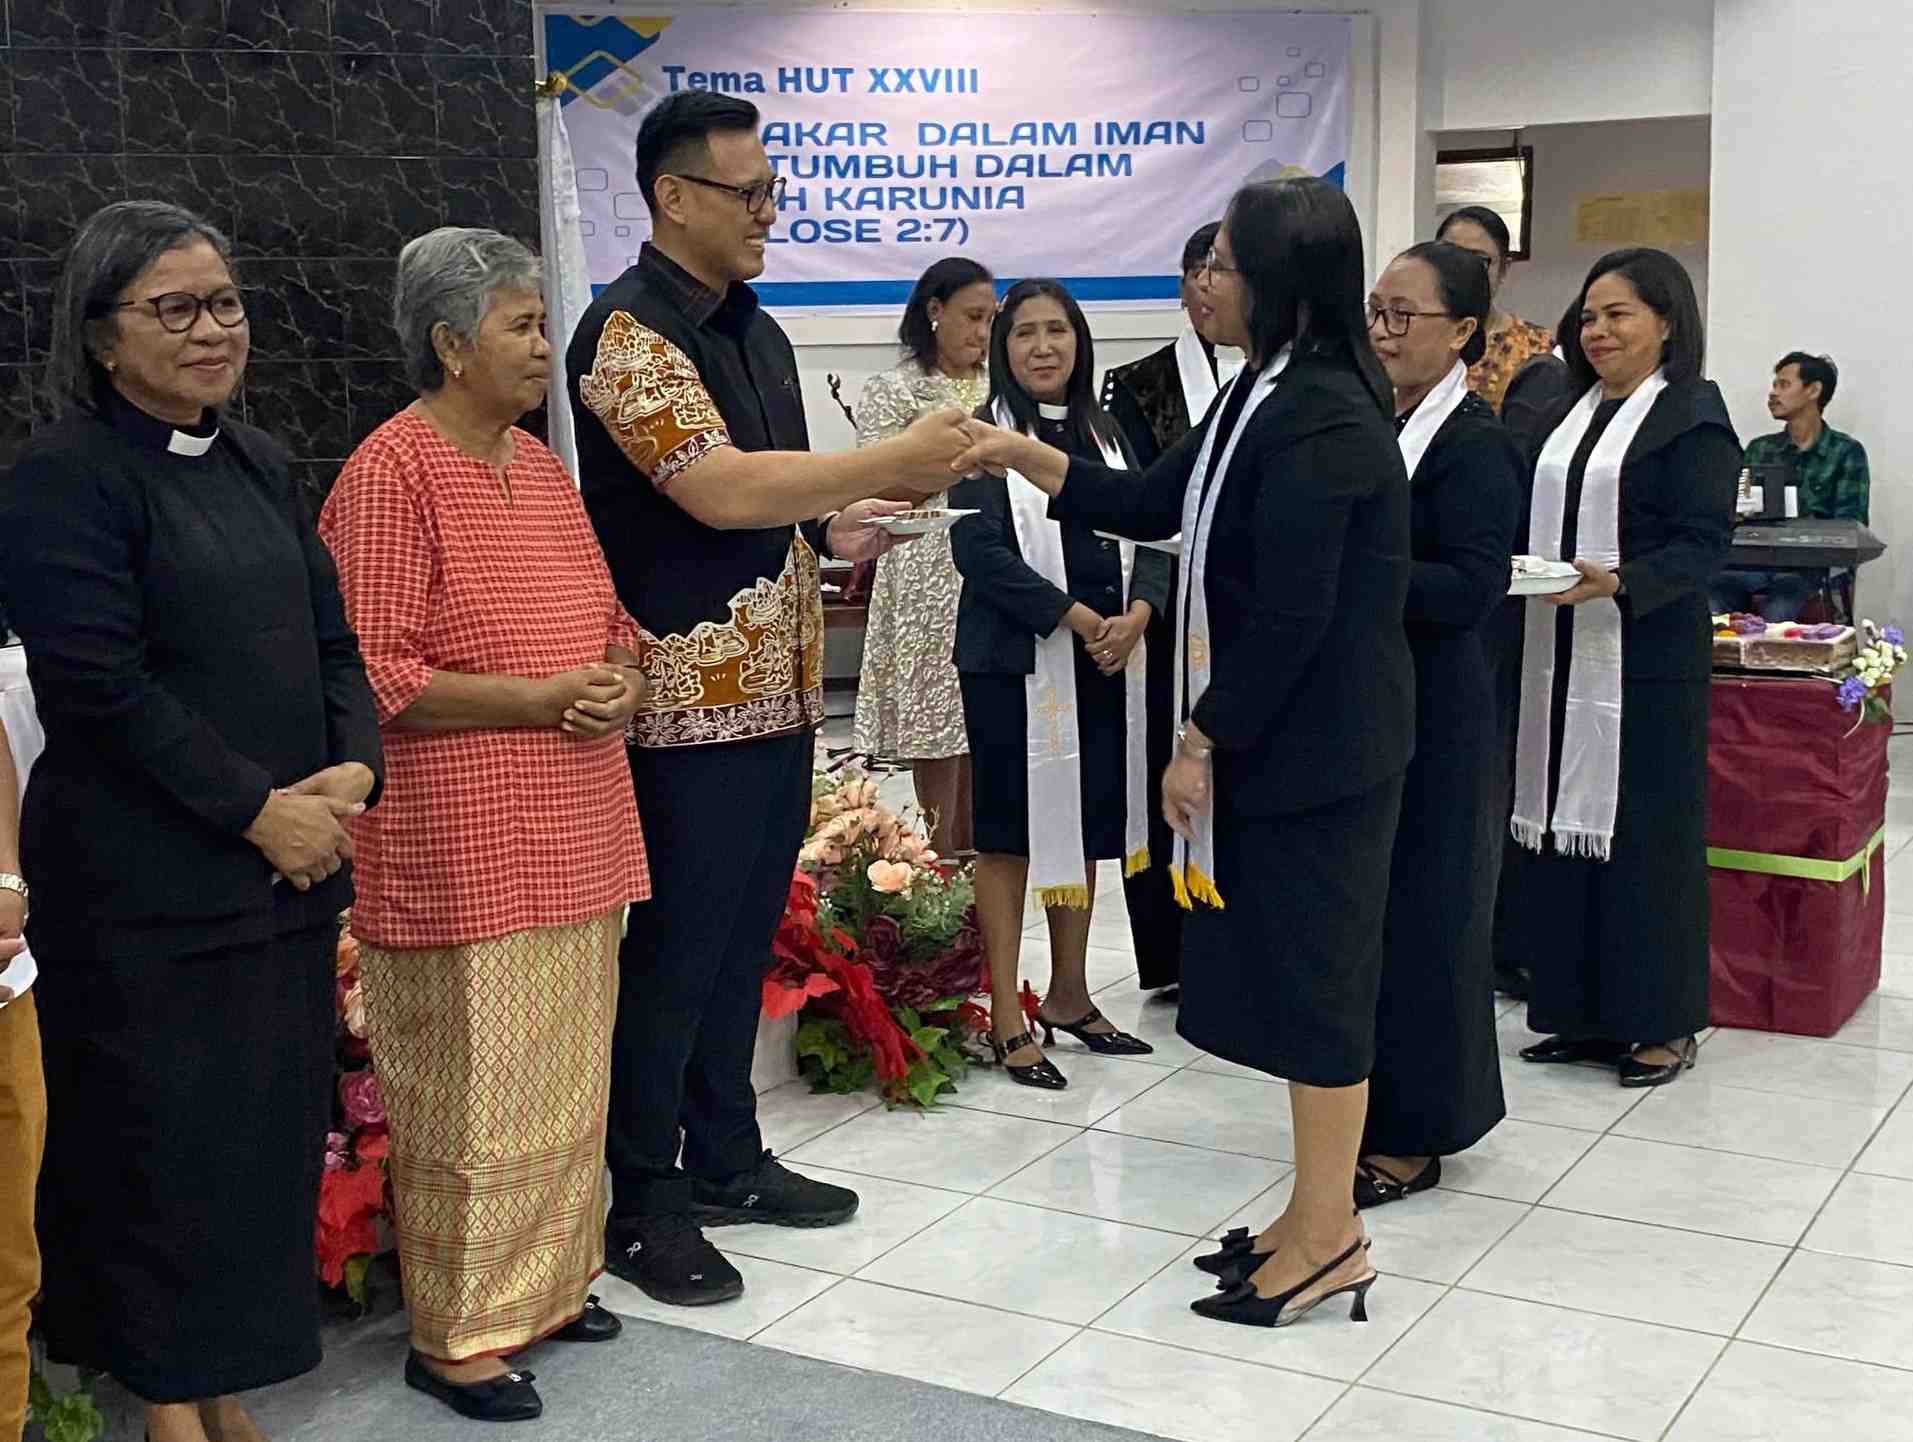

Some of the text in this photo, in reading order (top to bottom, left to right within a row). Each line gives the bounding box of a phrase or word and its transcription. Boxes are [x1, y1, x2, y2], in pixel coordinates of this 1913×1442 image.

[662, 65, 978, 93] Tema HUT XXVIII
[761, 120, 1205, 147] AKAR DALAM IMAN
[767, 153, 1132, 179] TUMBUH DALAM
[824, 186, 1025, 211] KARUNIA
[896, 216, 970, 246] 2:7)
